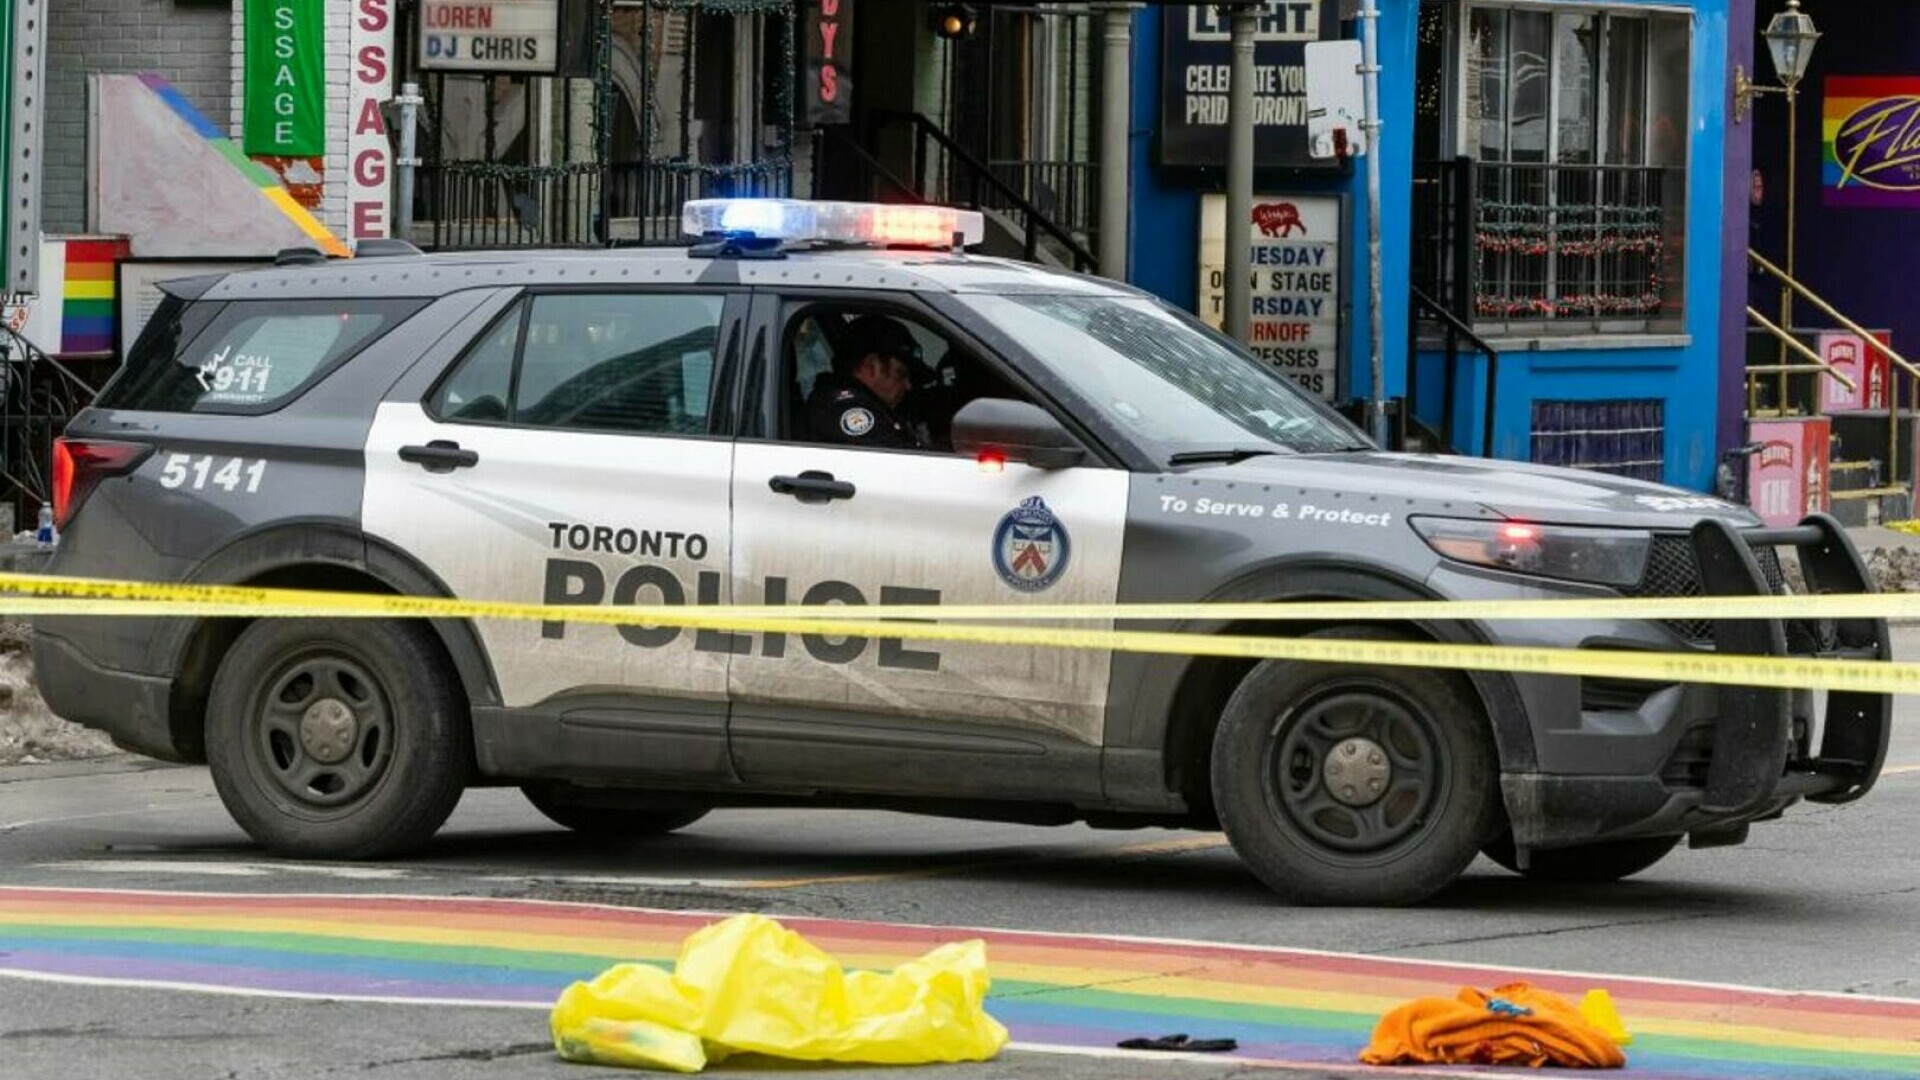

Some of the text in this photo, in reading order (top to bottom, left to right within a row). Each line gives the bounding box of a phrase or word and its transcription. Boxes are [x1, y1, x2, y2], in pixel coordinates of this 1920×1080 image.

[426, 6, 493, 28] LOREN
[426, 35, 537, 60] DJ CHRIS
[1186, 94, 1230, 124] PRID
[1271, 271, 1333, 292] STAGE
[1211, 295, 1324, 316] TRSDAY
[234, 355, 272, 368] CALL
[159, 453, 267, 493] 5141
[1160, 495, 1391, 526] To Serve & Protect
[548, 522, 708, 560] TORONTO
[541, 558, 942, 673] POLICE
